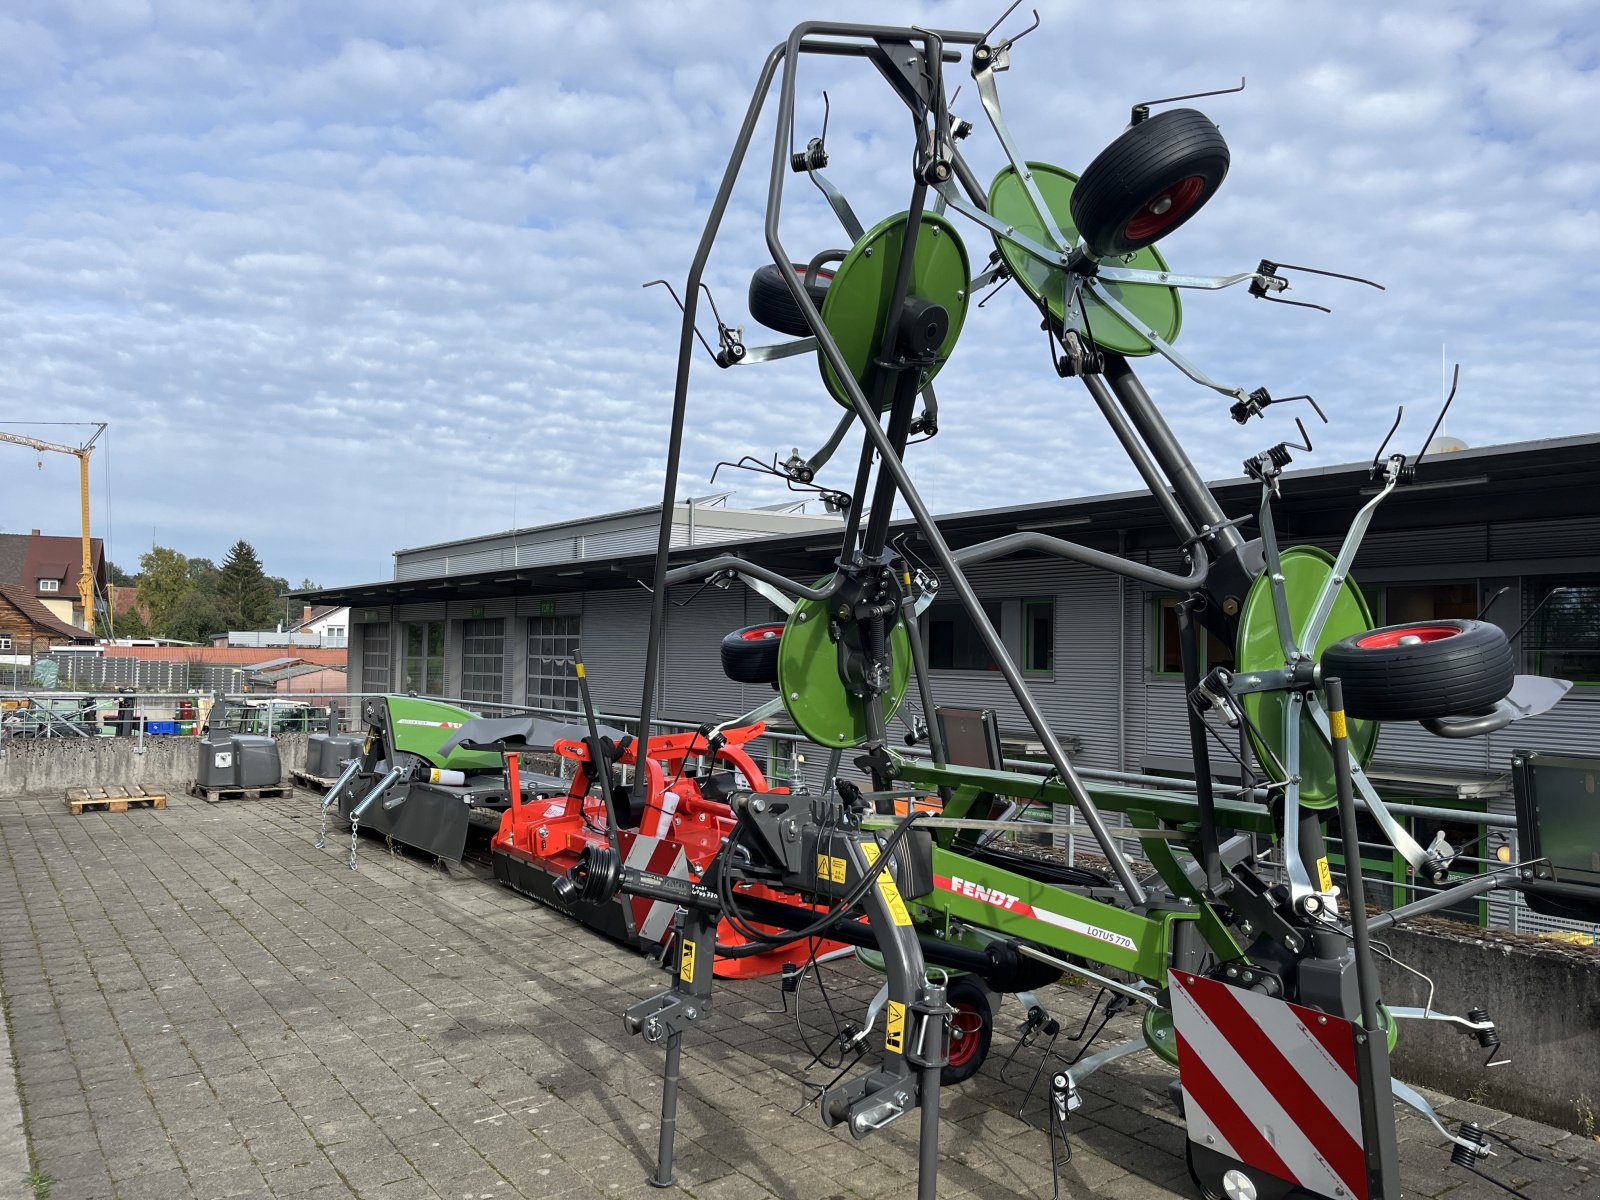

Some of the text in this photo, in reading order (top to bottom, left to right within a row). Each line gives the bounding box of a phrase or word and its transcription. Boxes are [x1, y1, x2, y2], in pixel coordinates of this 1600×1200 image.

[951, 876, 1020, 909] FENDT
[1087, 926, 1131, 948] LOTUS 770
